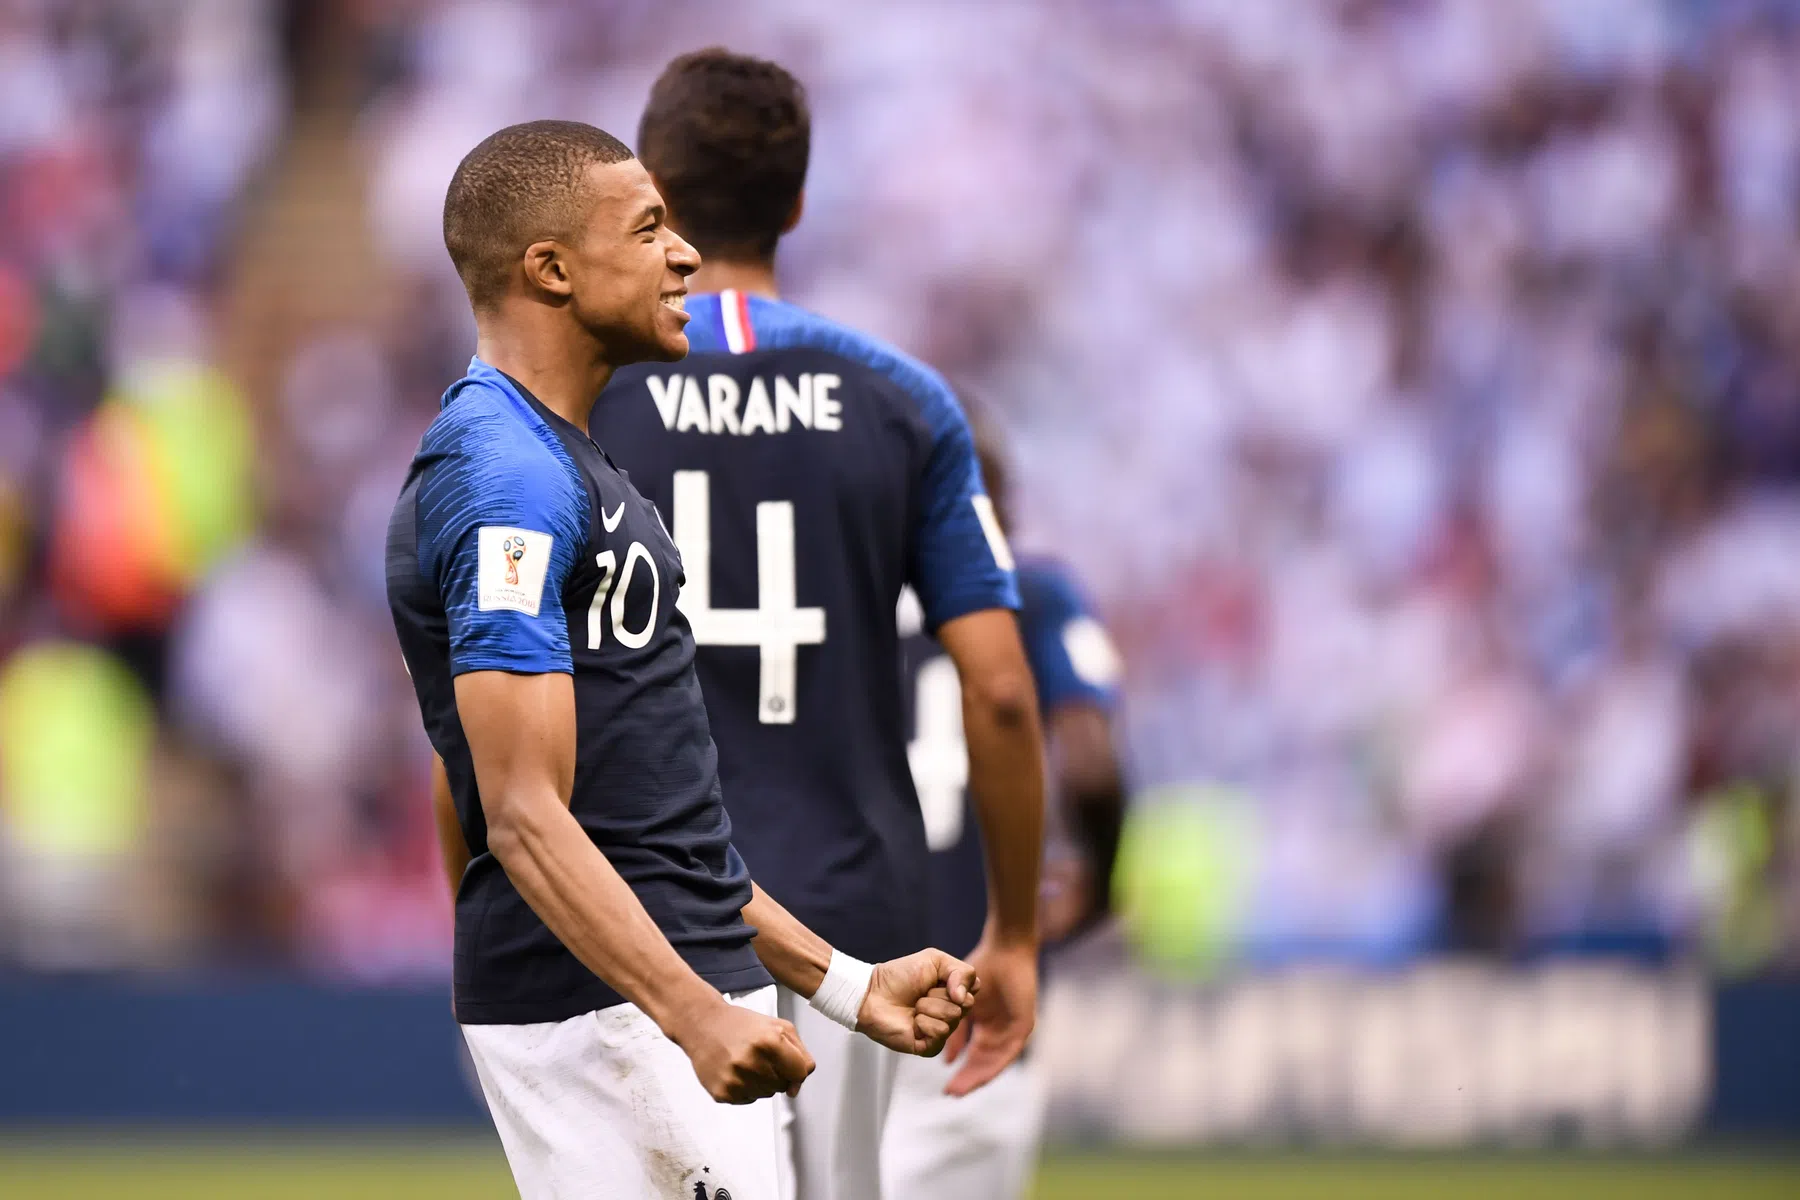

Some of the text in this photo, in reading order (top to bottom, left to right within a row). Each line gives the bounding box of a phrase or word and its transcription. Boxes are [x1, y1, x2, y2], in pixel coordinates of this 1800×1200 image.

[646, 373, 843, 435] VARANE
[587, 541, 660, 650] 10
[674, 470, 826, 724] 4
